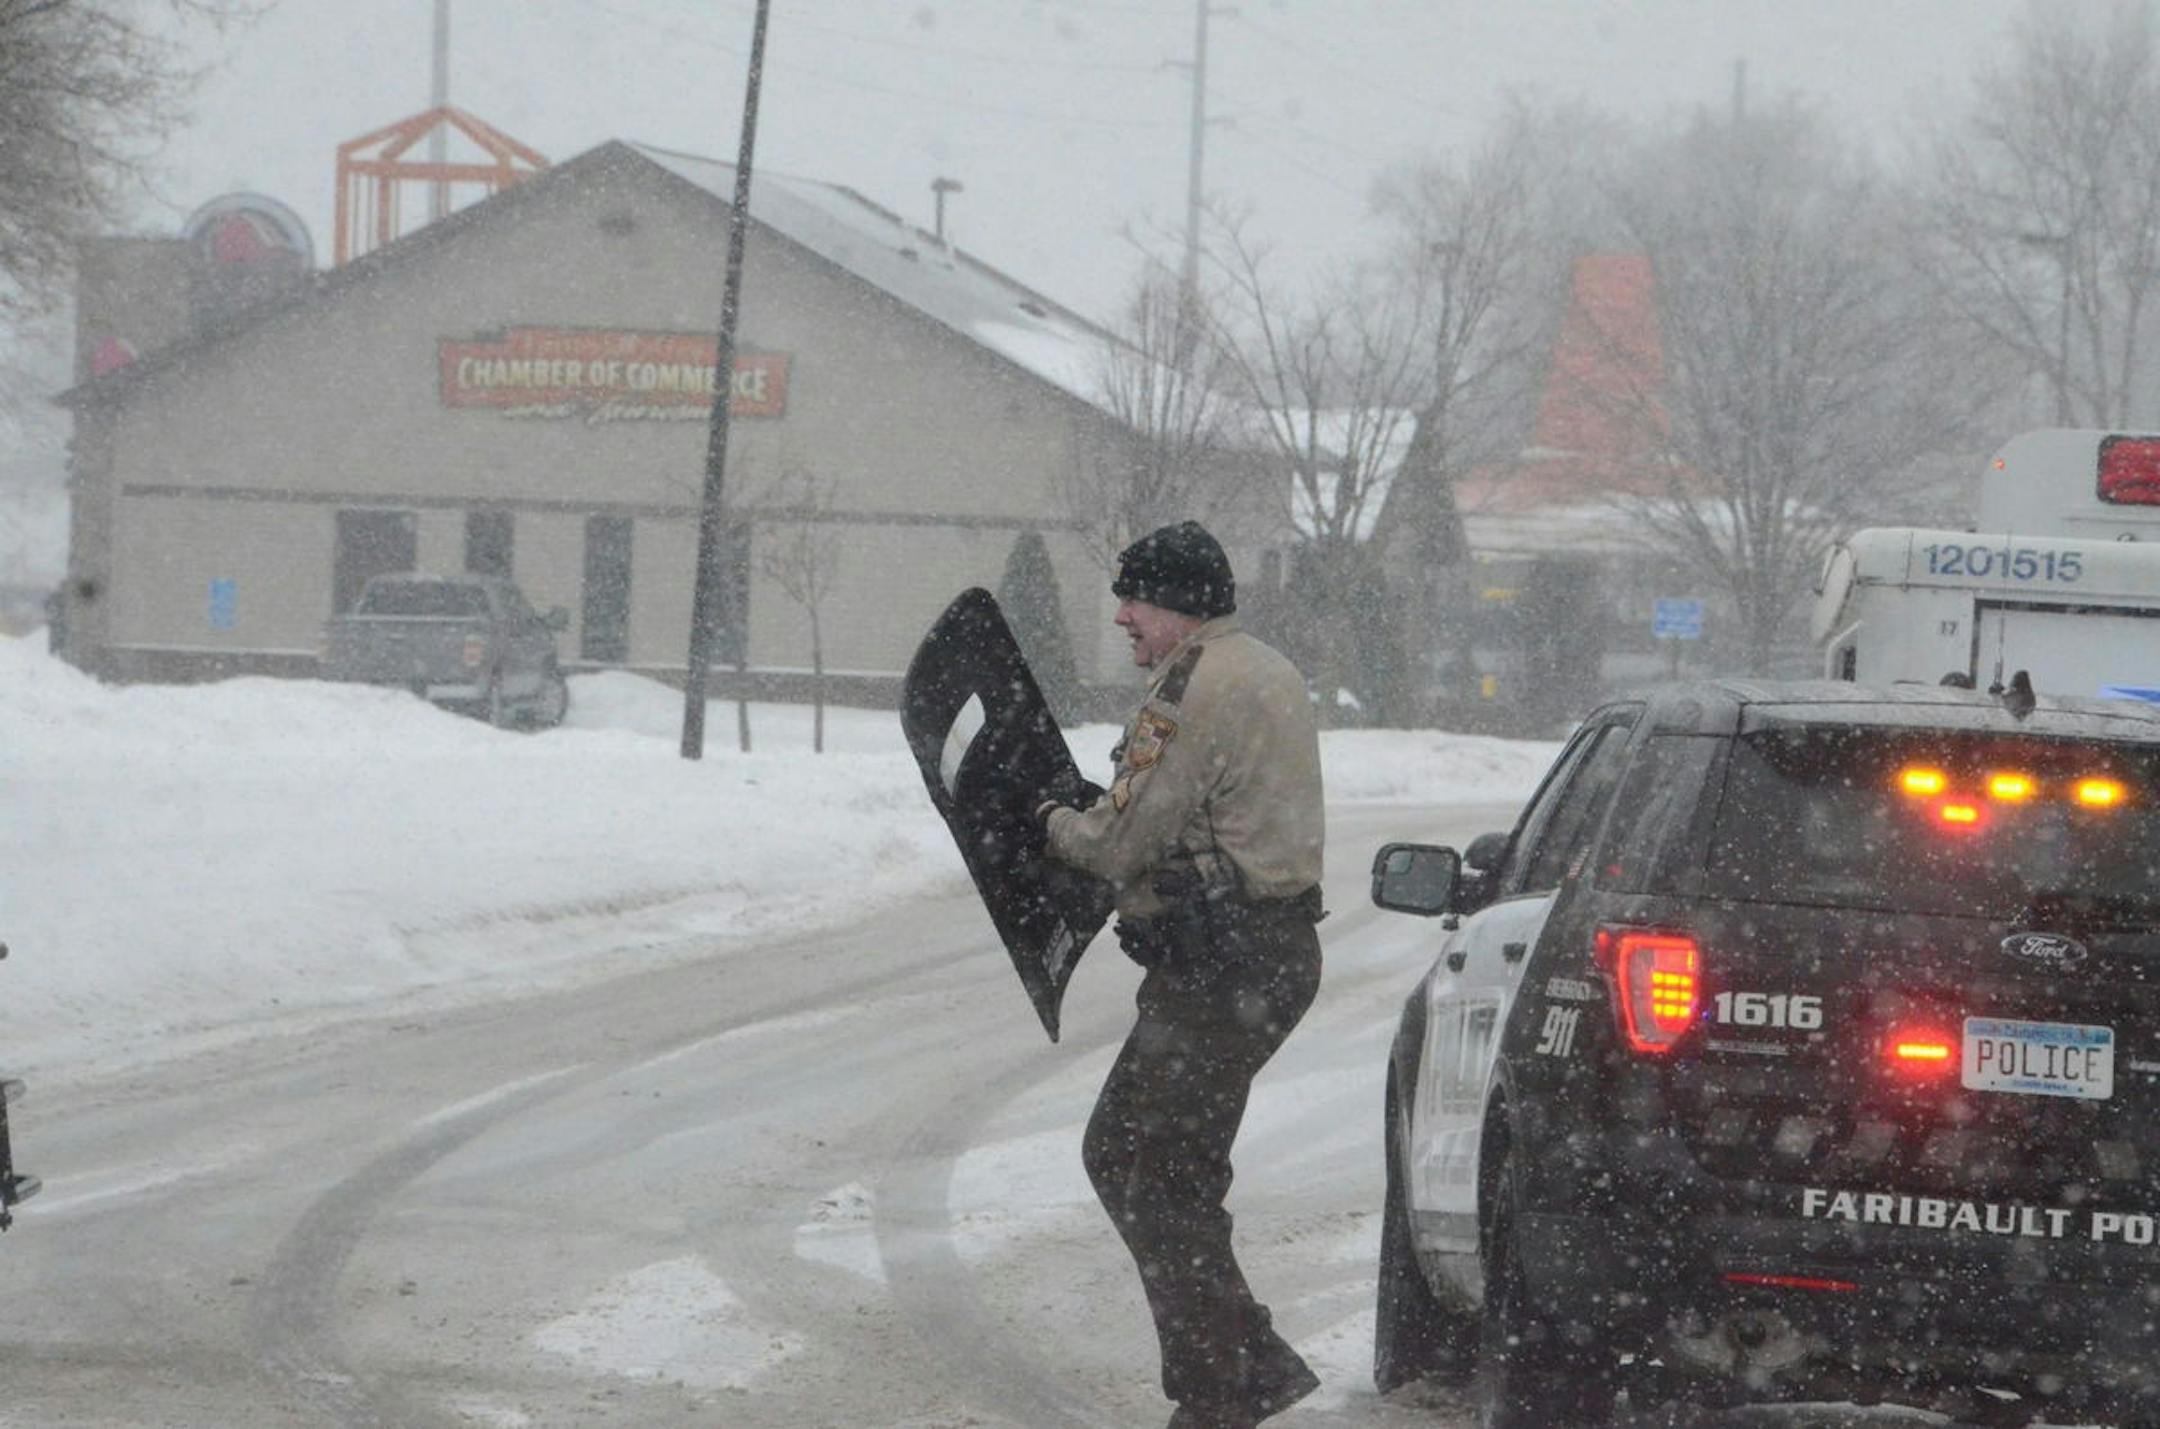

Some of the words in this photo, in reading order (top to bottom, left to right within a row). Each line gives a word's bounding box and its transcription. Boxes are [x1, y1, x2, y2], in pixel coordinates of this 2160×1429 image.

[458, 357, 581, 389] CHAMBER
[589, 359, 624, 386] OF
[1924, 543, 2083, 583] 1201515
[2020, 936, 2069, 958] Ford
[1715, 991, 1822, 1029] 1616
[1535, 1005, 1582, 1058] 911
[1976, 1038, 2102, 1083] POLICE
[1802, 1187, 2071, 1239] FARIBAULT
[2092, 1212, 2160, 1245] PO
